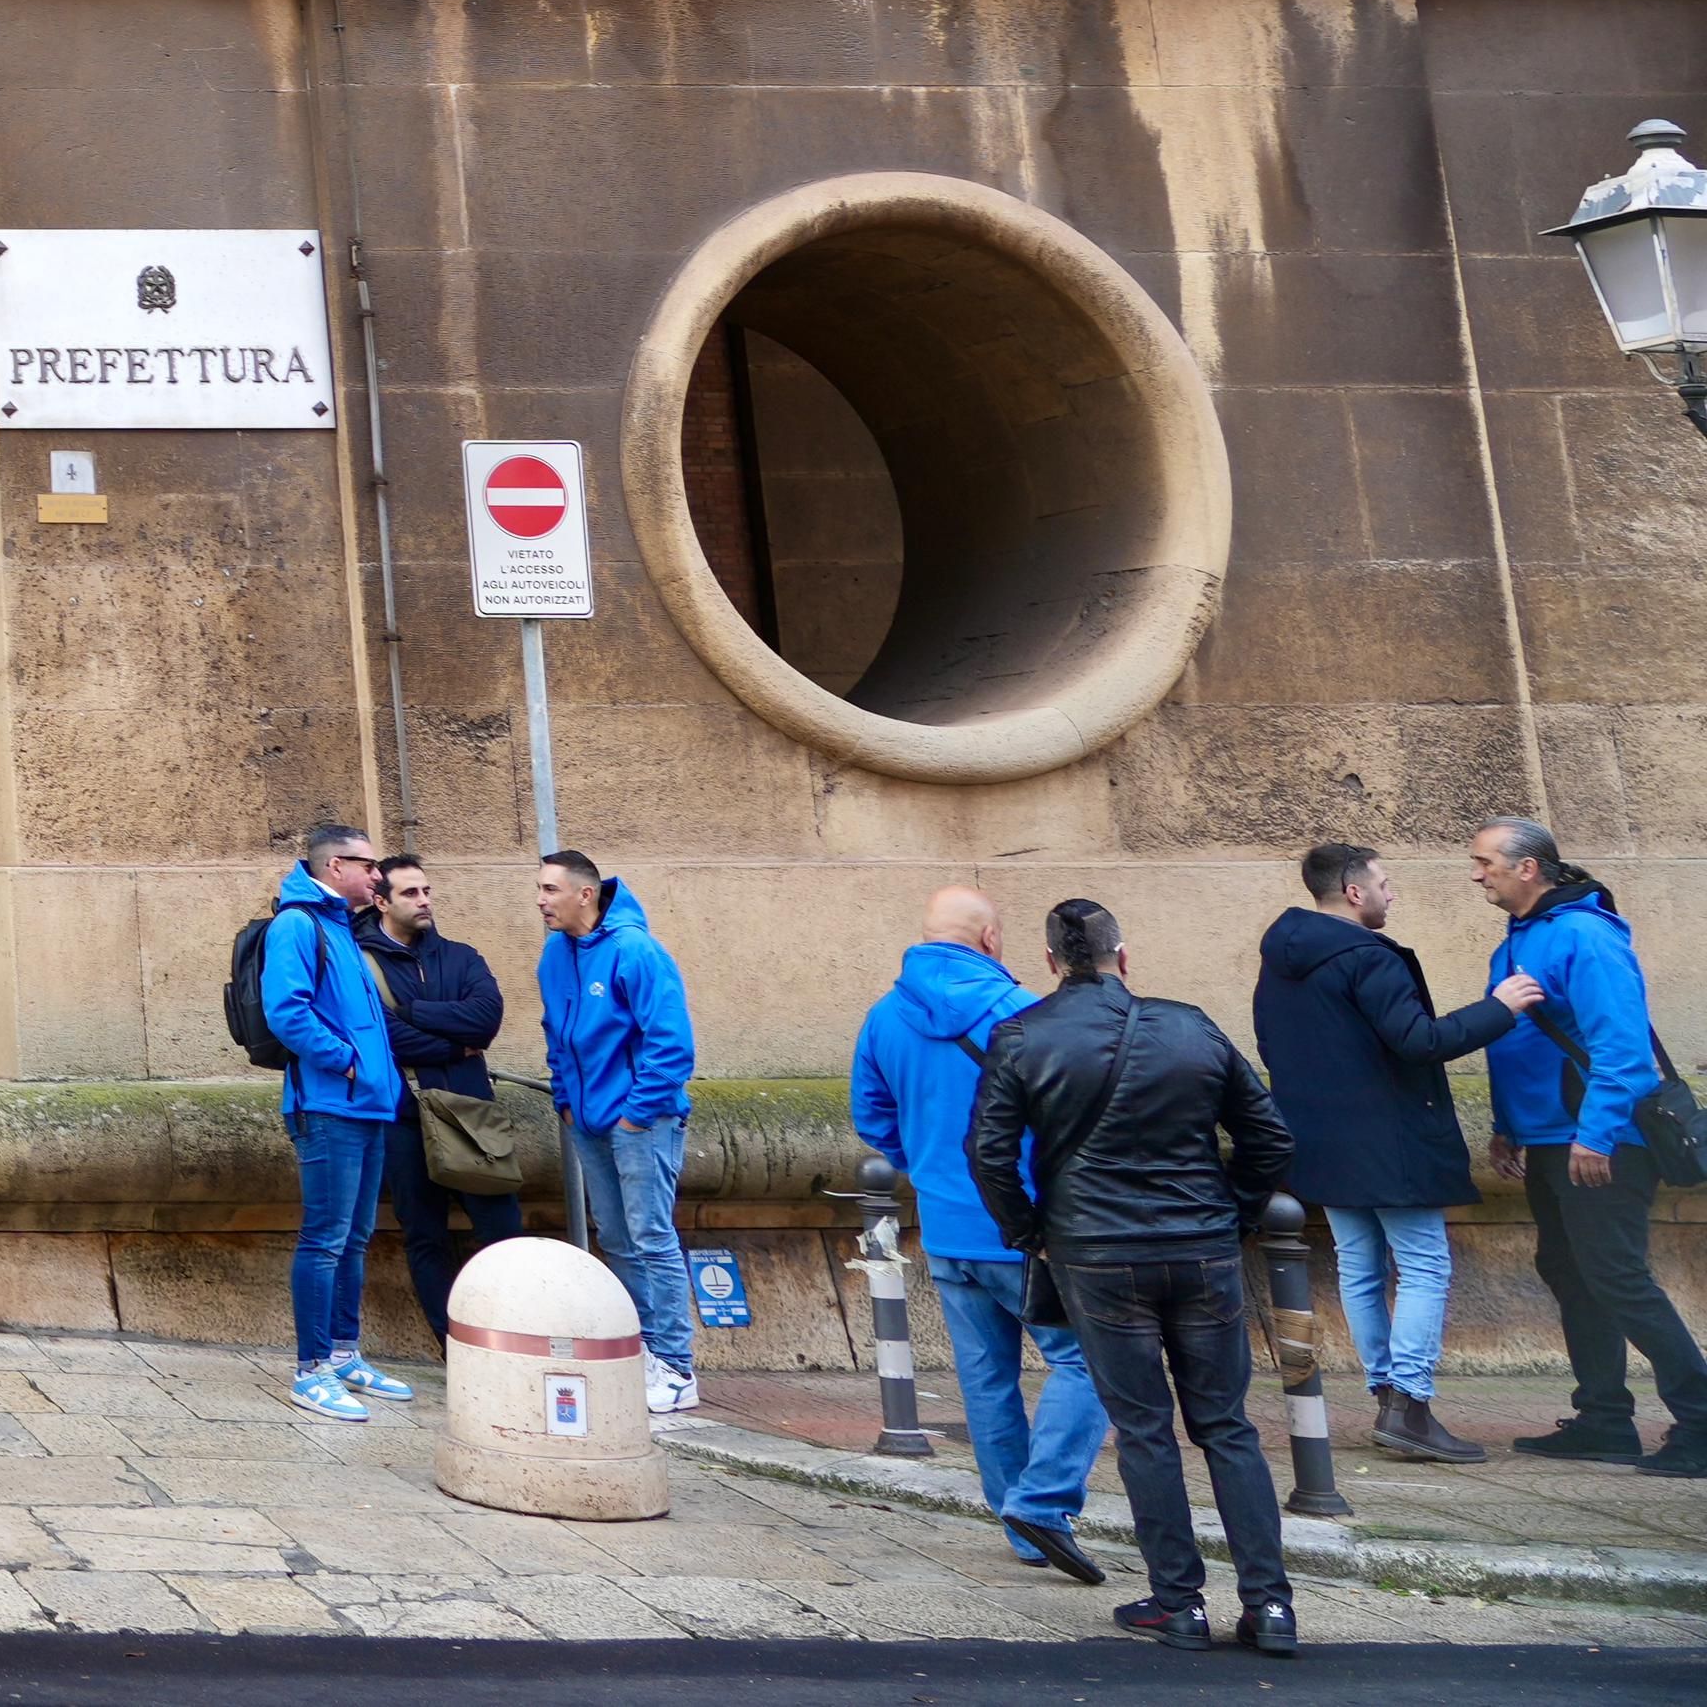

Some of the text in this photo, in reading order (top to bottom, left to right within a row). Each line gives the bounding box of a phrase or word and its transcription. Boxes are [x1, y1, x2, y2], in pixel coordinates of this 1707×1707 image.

[9, 346, 314, 384] PREFETTURA
[66, 463, 77, 480] 4
[507, 549, 554, 559] VIETATO
[500, 565, 564, 574] L'ACCESSO
[482, 580, 585, 589] AGLI AUTOVEICOLI
[485, 595, 585, 605] NON AUTORIZZATI
